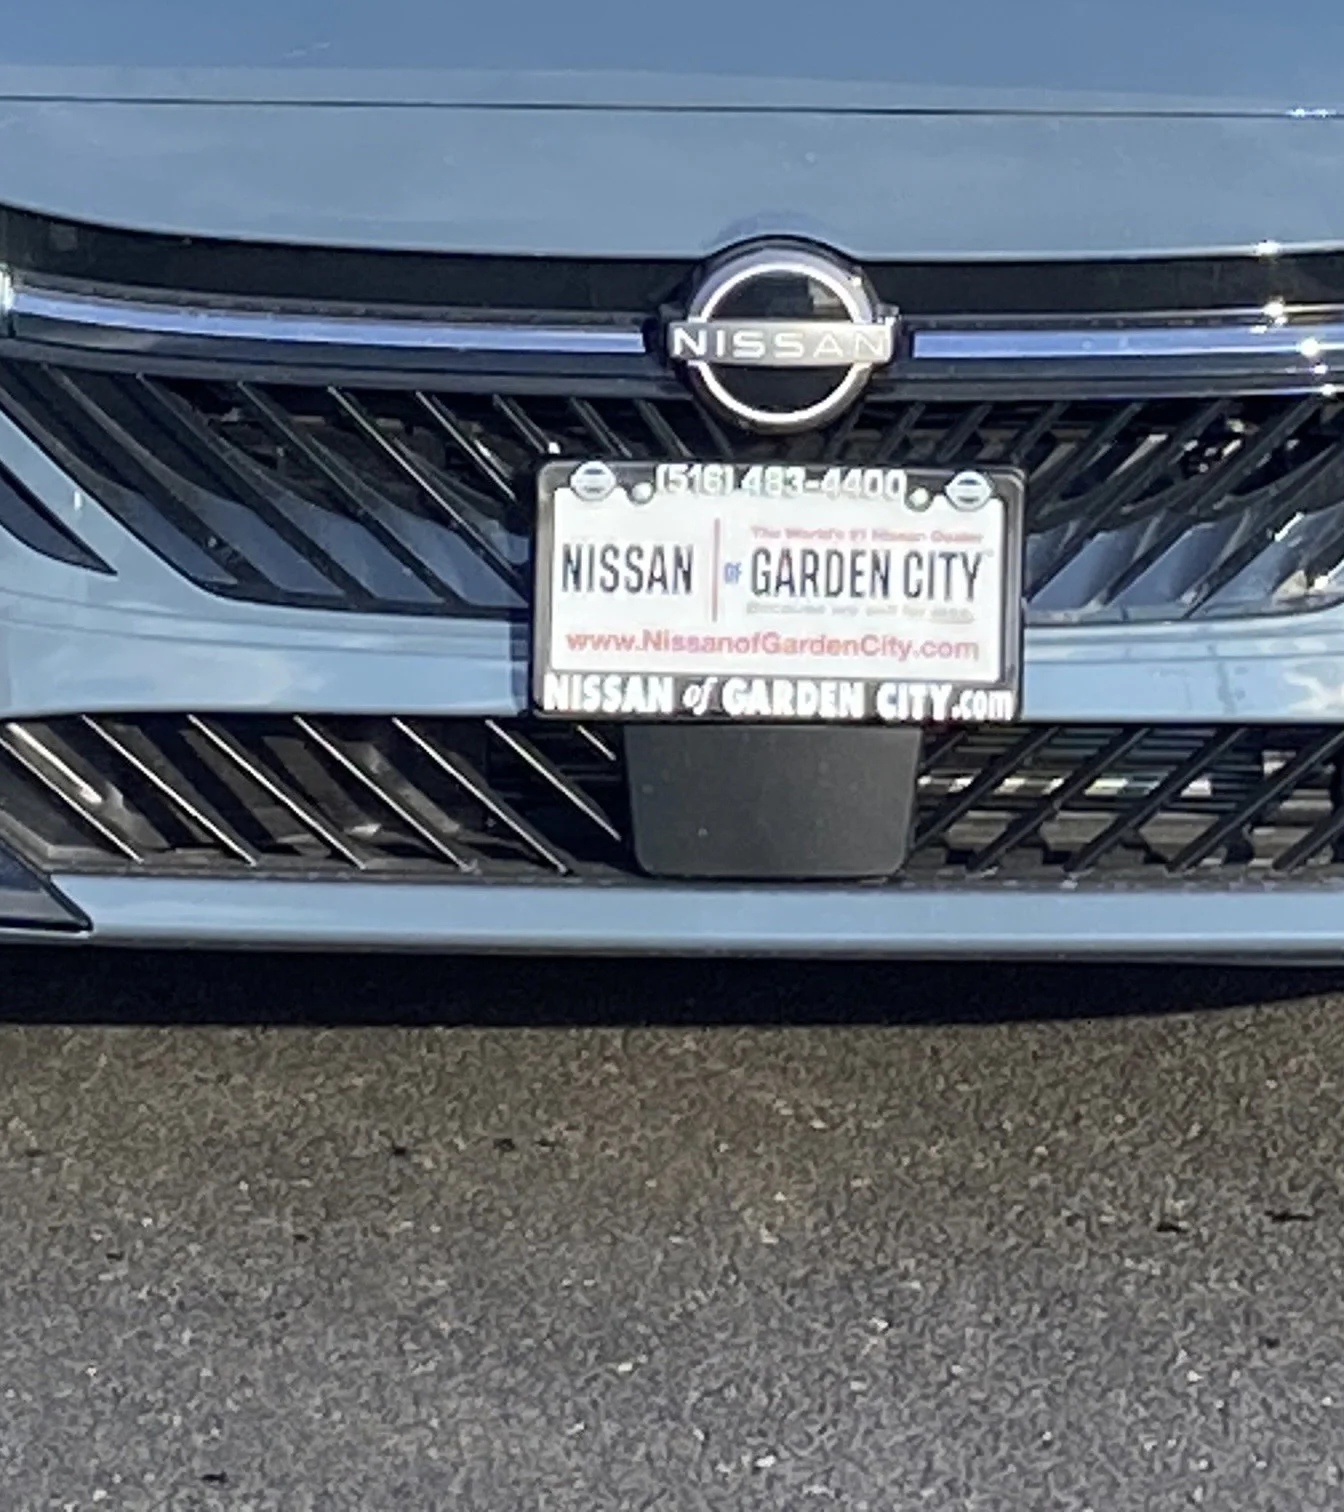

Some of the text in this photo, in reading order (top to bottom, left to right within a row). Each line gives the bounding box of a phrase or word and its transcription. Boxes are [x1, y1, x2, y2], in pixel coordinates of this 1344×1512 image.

[672, 327, 885, 359] NISSAN
[657, 463, 907, 500] (516) 483-4400
[562, 543, 694, 595] NISSAN
[750, 547, 891, 600] GARDEN
[903, 549, 983, 602] CITY
[565, 629, 980, 662] www.NissanofGardenCity.com
[543, 671, 1016, 722] NISSAN of GARDEN CITY.com
